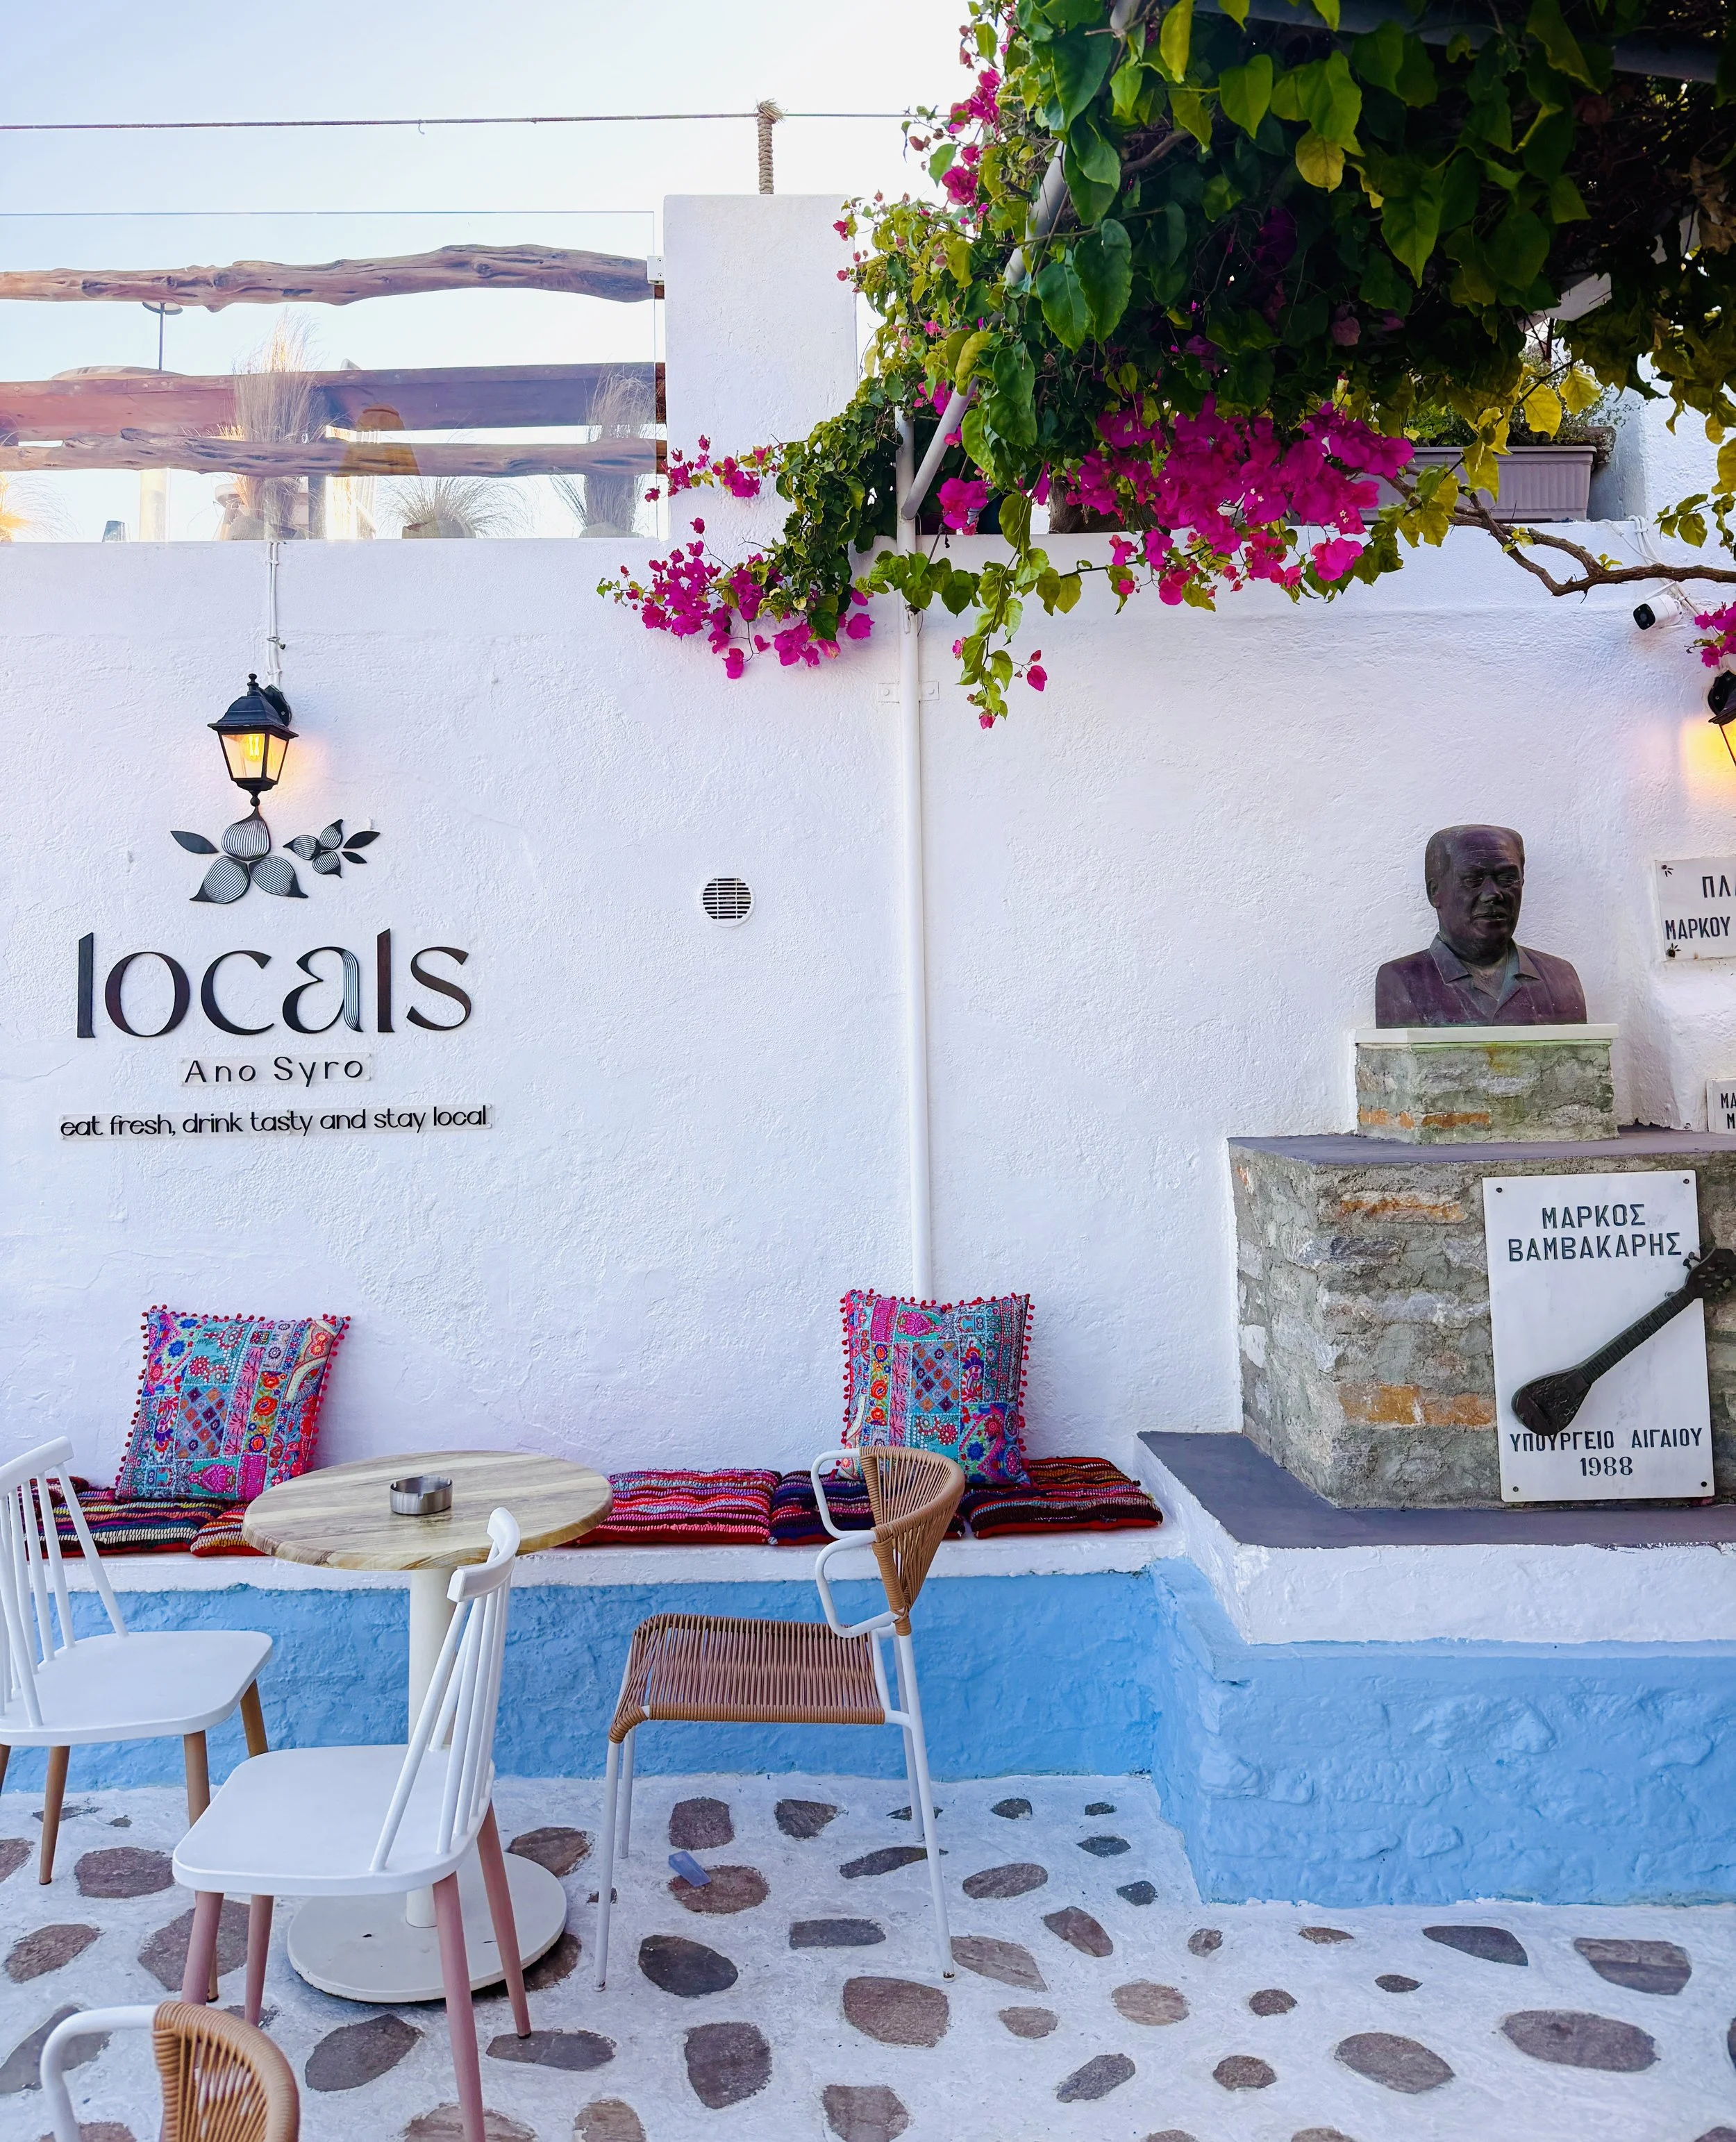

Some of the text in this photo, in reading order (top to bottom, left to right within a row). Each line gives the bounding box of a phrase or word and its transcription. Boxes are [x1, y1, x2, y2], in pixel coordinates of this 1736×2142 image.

[1702, 875, 1736, 898] ΠΛ
[1664, 916, 1730, 940] ΜΑΡΚΟΥ
[76, 928, 472, 1039] locals
[184, 1056, 363, 1088] Ano Syro
[60, 1105, 487, 1137] eat fresh, drink tasty and stay local
[1542, 1203, 1646, 1230] ΜΑΡΚΟΣ
[1508, 1232, 1682, 1262] ΒΑΜΒΑΚΑΡΗΣ
[1509, 1428, 1703, 1453] ΥΠΟΥΡΓΕΙΟ ΑΙΓΑΙΟΥ
[1580, 1456, 1633, 1477] 1988
